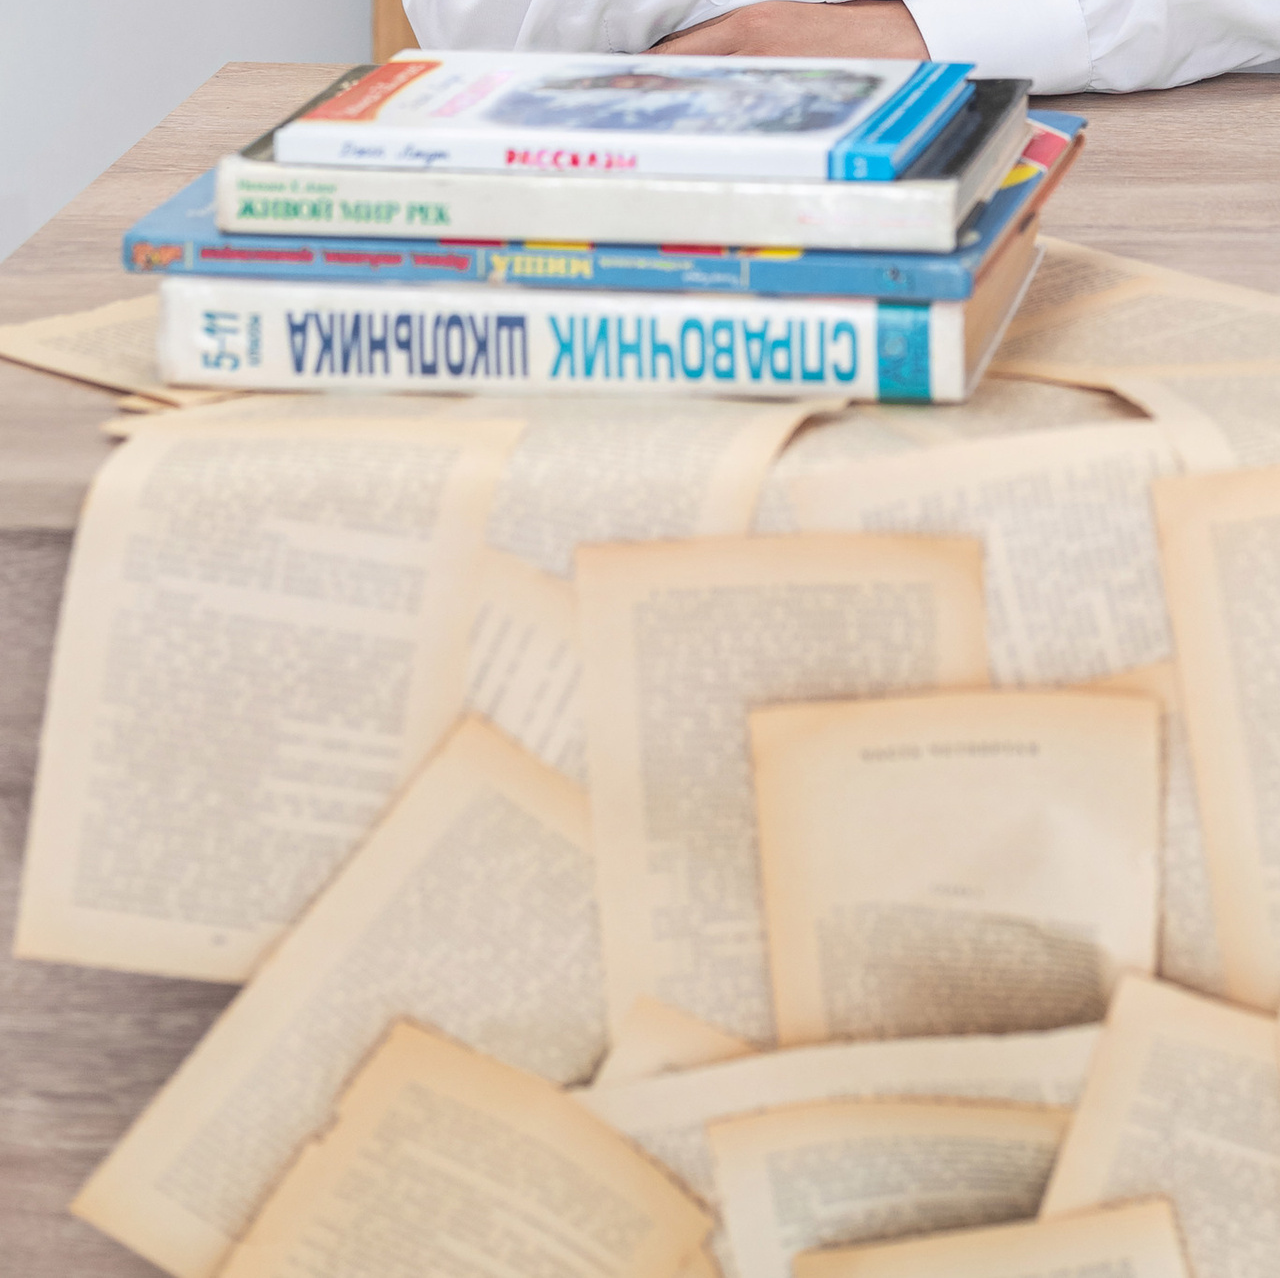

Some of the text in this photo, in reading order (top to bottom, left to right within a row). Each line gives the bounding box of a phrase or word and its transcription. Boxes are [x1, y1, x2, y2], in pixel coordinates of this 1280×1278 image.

[506, 148, 638, 170] РАССКАЗЫ
[237, 197, 451, 225] ЖИВОЙ МИР РЕК
[287, 312, 528, 375] ШКОЛЬНИКА
[549, 315, 858, 381] СПРАВОЧНИК
